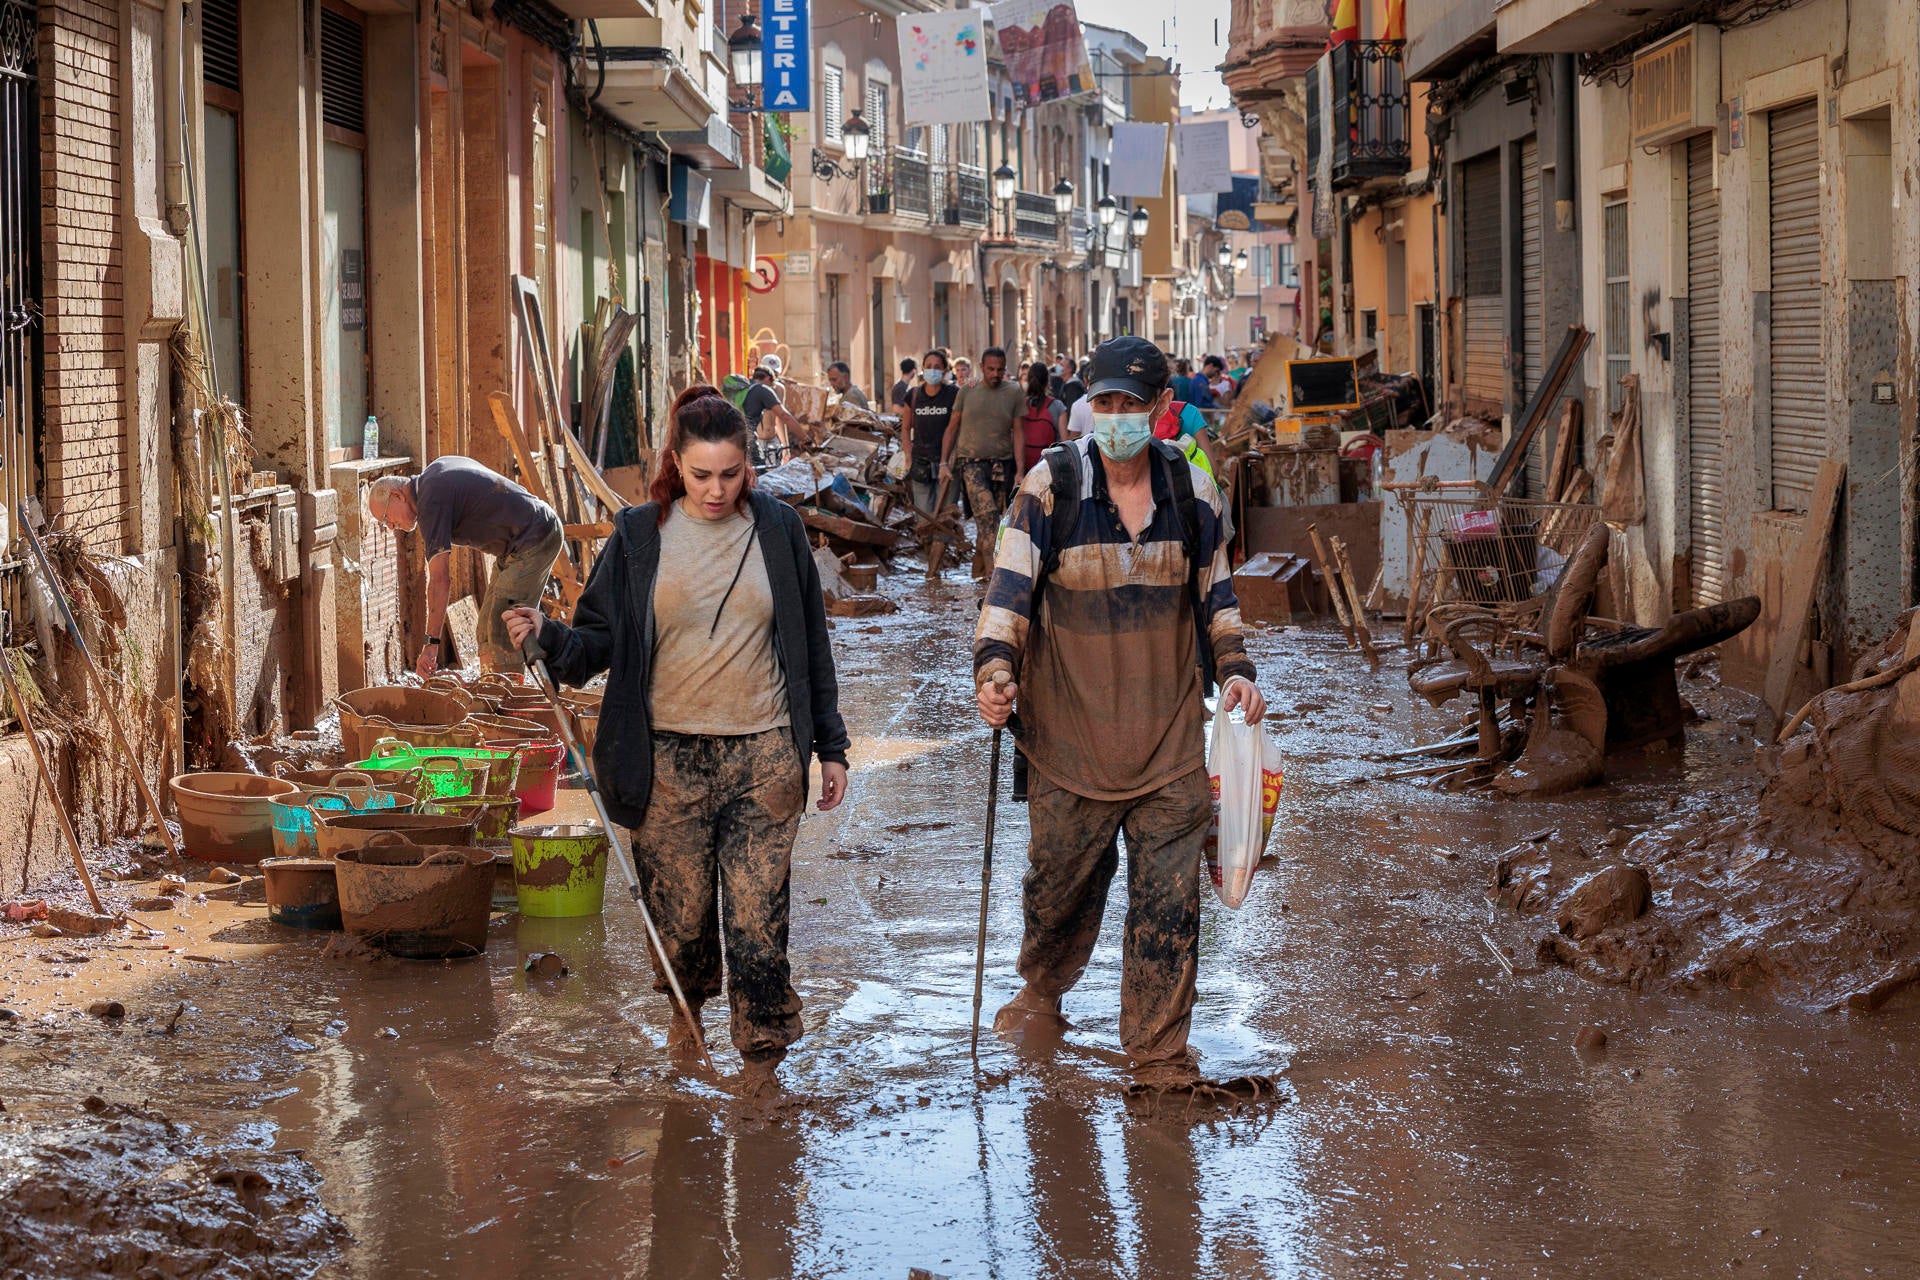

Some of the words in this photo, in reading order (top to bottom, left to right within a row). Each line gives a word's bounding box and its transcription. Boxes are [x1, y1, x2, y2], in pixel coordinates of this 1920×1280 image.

[772, 0, 797, 105] ETERIA
[1636, 52, 1672, 131] COMPRO
[1674, 41, 1692, 117] ORO
[915, 406, 948, 416] adidas
